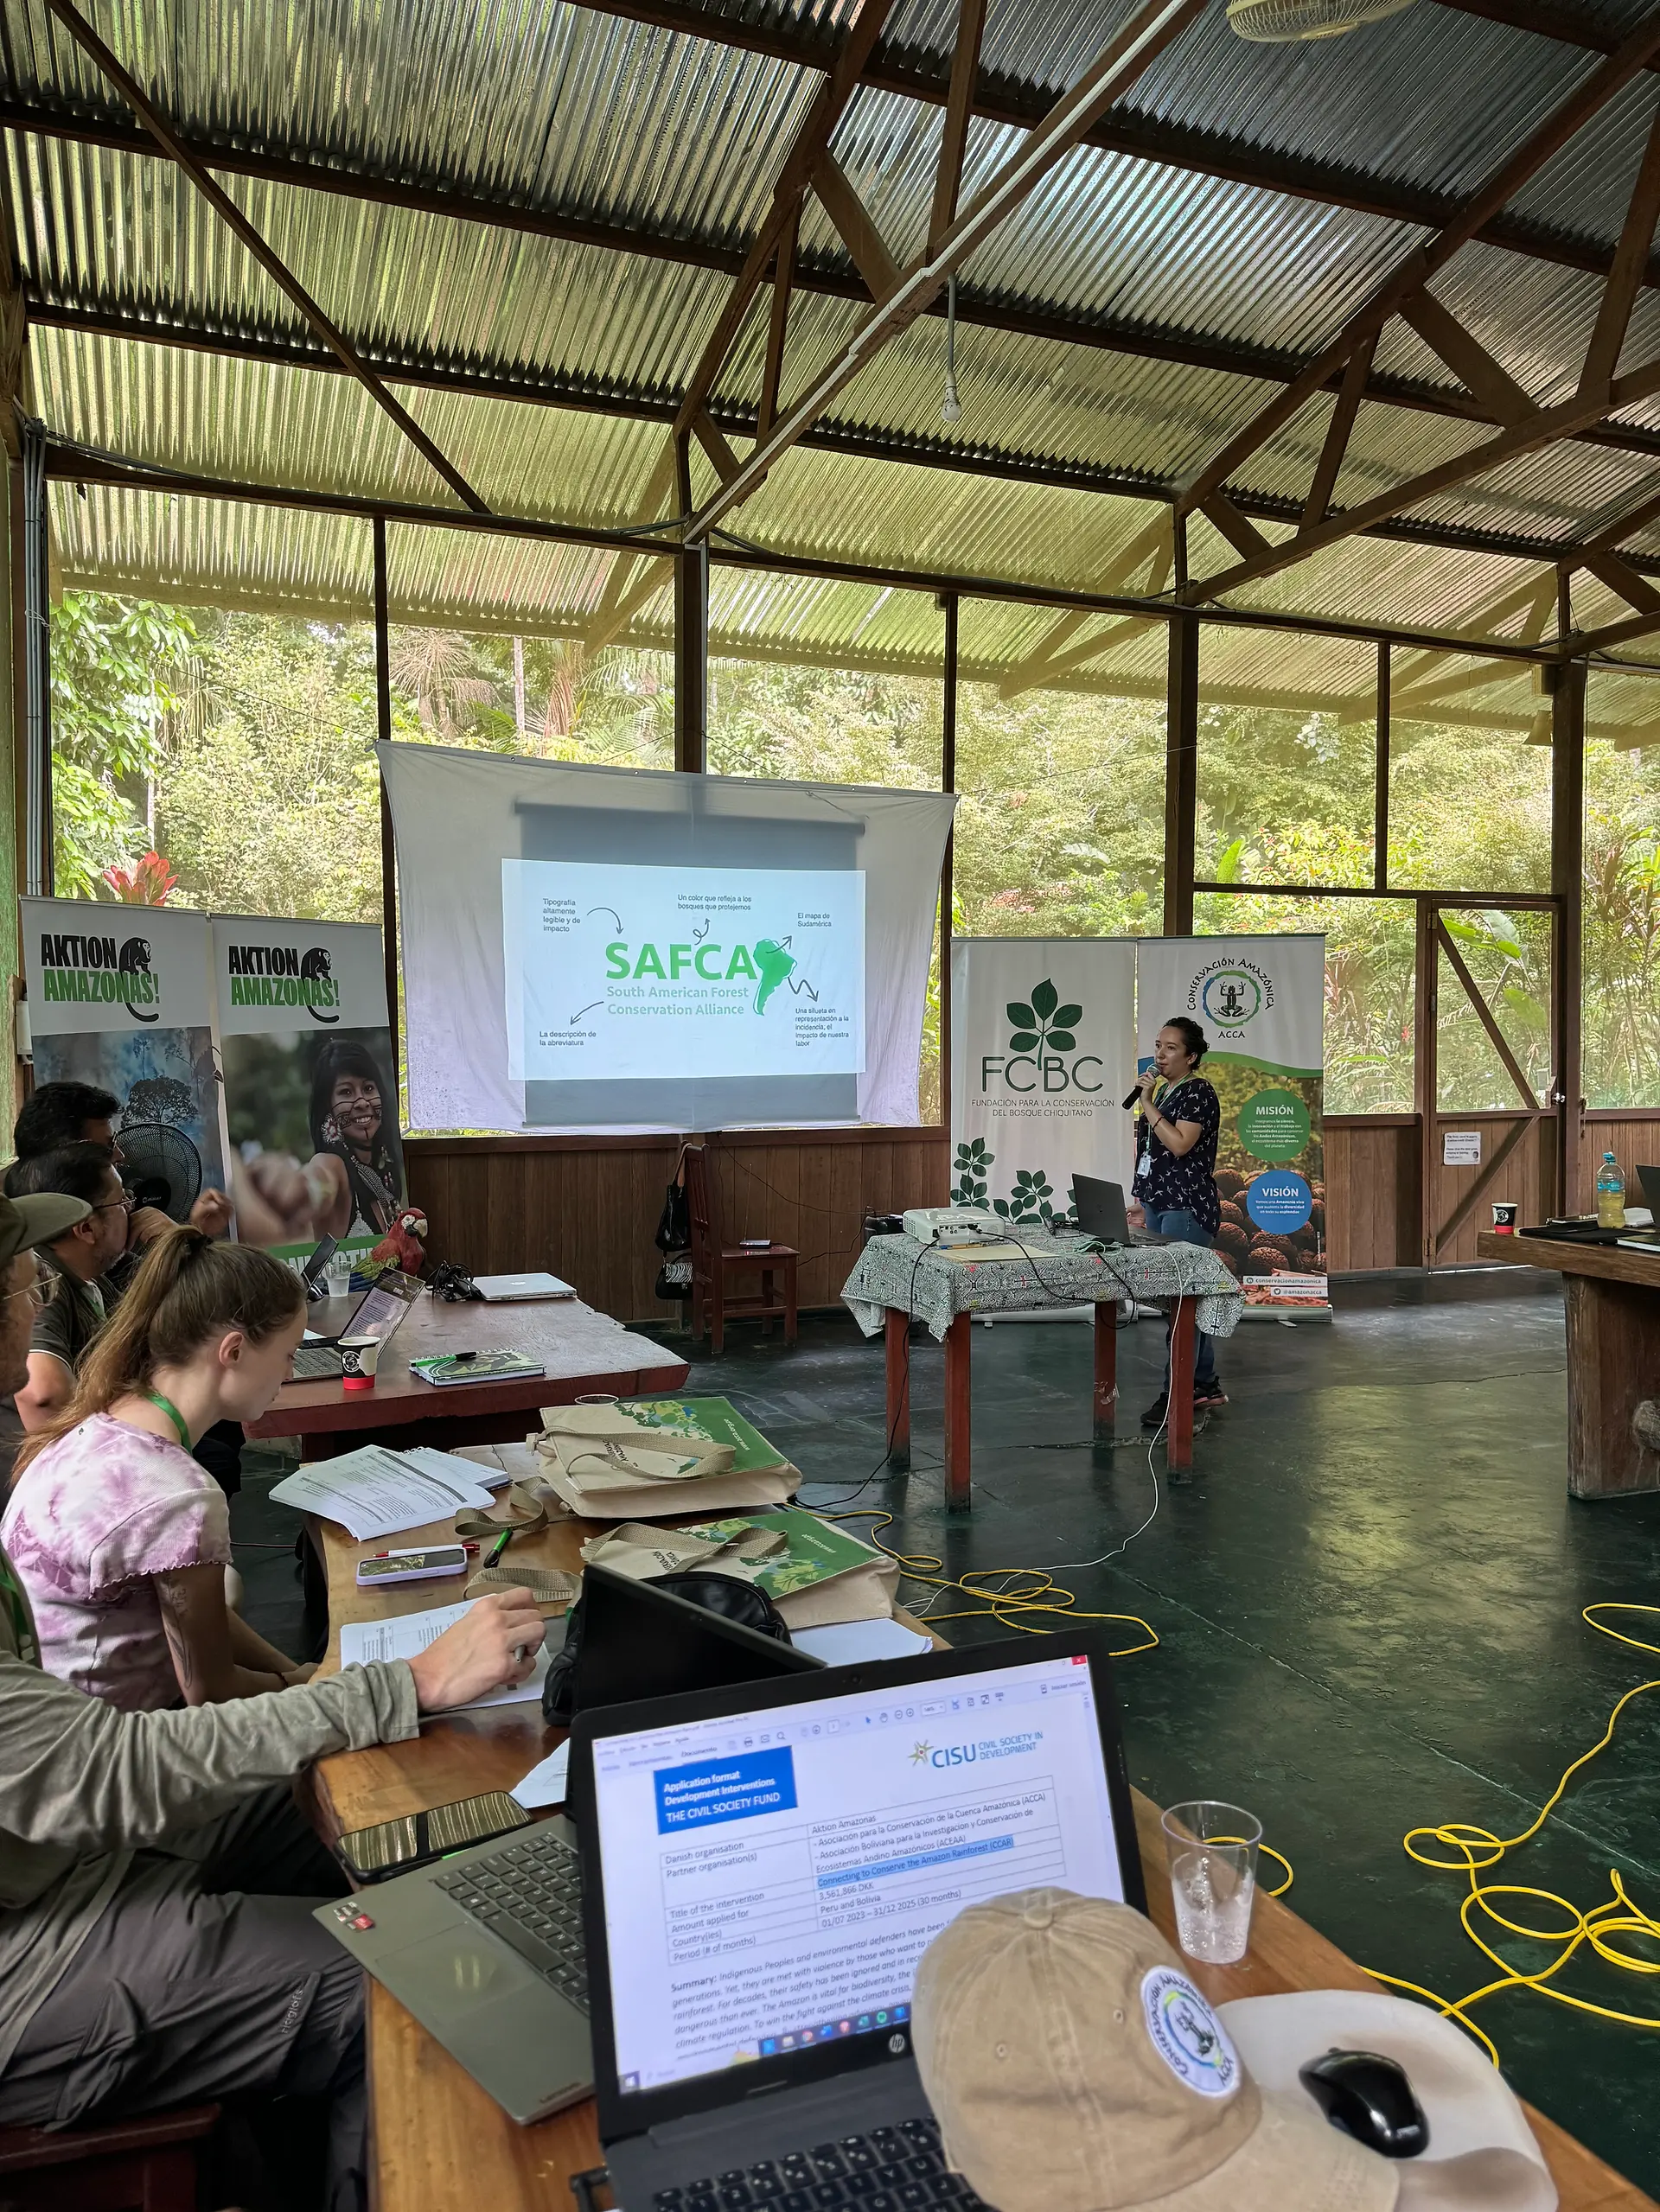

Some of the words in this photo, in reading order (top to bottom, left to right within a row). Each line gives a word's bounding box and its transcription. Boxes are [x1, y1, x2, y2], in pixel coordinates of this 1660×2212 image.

[543, 897, 576, 907] Tipografía
[543, 916, 565, 925] legible
[41, 933, 118, 969] AKTION
[228, 945, 299, 977] AKTION
[605, 941, 758, 980] SAFCA
[43, 967, 160, 1004] AMAZONAS!
[231, 976, 340, 1007] AMAZONAS!
[607, 986, 645, 998] South
[648, 986, 708, 998] American
[711, 987, 750, 998] Forest
[607, 1004, 693, 1016] Conservation
[695, 1004, 744, 1015] Alliance
[549, 1030, 586, 1039] descripción
[1217, 1030, 1246, 1039] ACCA
[982, 1056, 1103, 1092] FCBC
[1255, 1104, 1293, 1115] MISIÓN
[1262, 1186, 1299, 1196] VISIÓN
[978, 1740, 996, 1750] CIVIL
[999, 1732, 1032, 1746] SOCIETY
[1034, 1731, 1043, 1739] IN
[980, 1742, 1037, 1760] DEVELOPMENT
[931, 1743, 976, 1769] CISU
[663, 1775, 711, 1794] Application
[712, 1769, 740, 1783] format
[664, 1787, 719, 1807] Development
[721, 1776, 775, 1794] Interventions
[666, 1810, 685, 1822] THE
[687, 1805, 712, 1818] CIVIL
[712, 1797, 751, 1813] SOCIETY
[753, 1792, 780, 1805] FUND
[859, 1828, 877, 1839] para
[886, 1814, 935, 1832] Conservación
[954, 1806, 980, 1818] Cuenca
[1021, 1793, 1045, 1805] (ACCA)
[812, 1822, 836, 1833] Aktion
[838, 1814, 876, 1828] Amazonas
[861, 1836, 894, 1851] Boliviana
[896, 1833, 913, 1844] para
[1024, 1807, 1033, 1816] de
[665, 1851, 693, 1864] Danish
[694, 1841, 744, 1859] organisation
[667, 1865, 696, 1877] Partner
[698, 1852, 757, 1872] organisation(s)
[816, 1857, 861, 1873] Ecosistemas
[863, 1851, 890, 1863] Andino
[936, 1834, 966, 1848] (ACEAA)
[817, 1871, 860, 1889] Connecting
[872, 1860, 905, 1875] Conserve
[907, 1857, 919, 1867] the
[921, 1851, 950, 1865] Amazon
[952, 1842, 988, 1858] Rainforest
[989, 1837, 1013, 1850] (CCAR)
[819, 1884, 857, 1901] 3,561,866
[858, 1881, 873, 1891] DKK
[820, 1903, 838, 1914] Peru
[840, 1899, 854, 1909] and
[856, 1893, 881, 1905] Bolivia
[670, 1908, 687, 1919] Title
[690, 1905, 699, 1915] of
[700, 1902, 713, 1912] the
[716, 1891, 763, 1909] intervention
[821, 1915, 845, 1928] 01/07
[846, 1910, 865, 1922] 2023
[873, 1903, 895, 1916] 31/12
[897, 1899, 916, 1910] 2025
[917, 1896, 929, 1907] (30
[930, 1889, 961, 1903] months)
[671, 1919, 704, 1933] Amount
[706, 1912, 735, 1927] applied
[737, 1909, 749, 1918] for
[673, 1928, 722, 1948] Country(ies)
[674, 1947, 700, 1961] Period
[712, 1943, 720, 1953] of
[723, 1935, 756, 1951] months)
[671, 1973, 717, 1994] Summary:
[719, 1963, 763, 1983] Indigenous
[764, 1956, 794, 1972] Peoples
[795, 1952, 811, 1962] and
[813, 1939, 867, 1959] environmental
[869, 1929, 906, 1946] defenders
[908, 1925, 925, 1936] have
[927, 1921, 944, 1932] been
